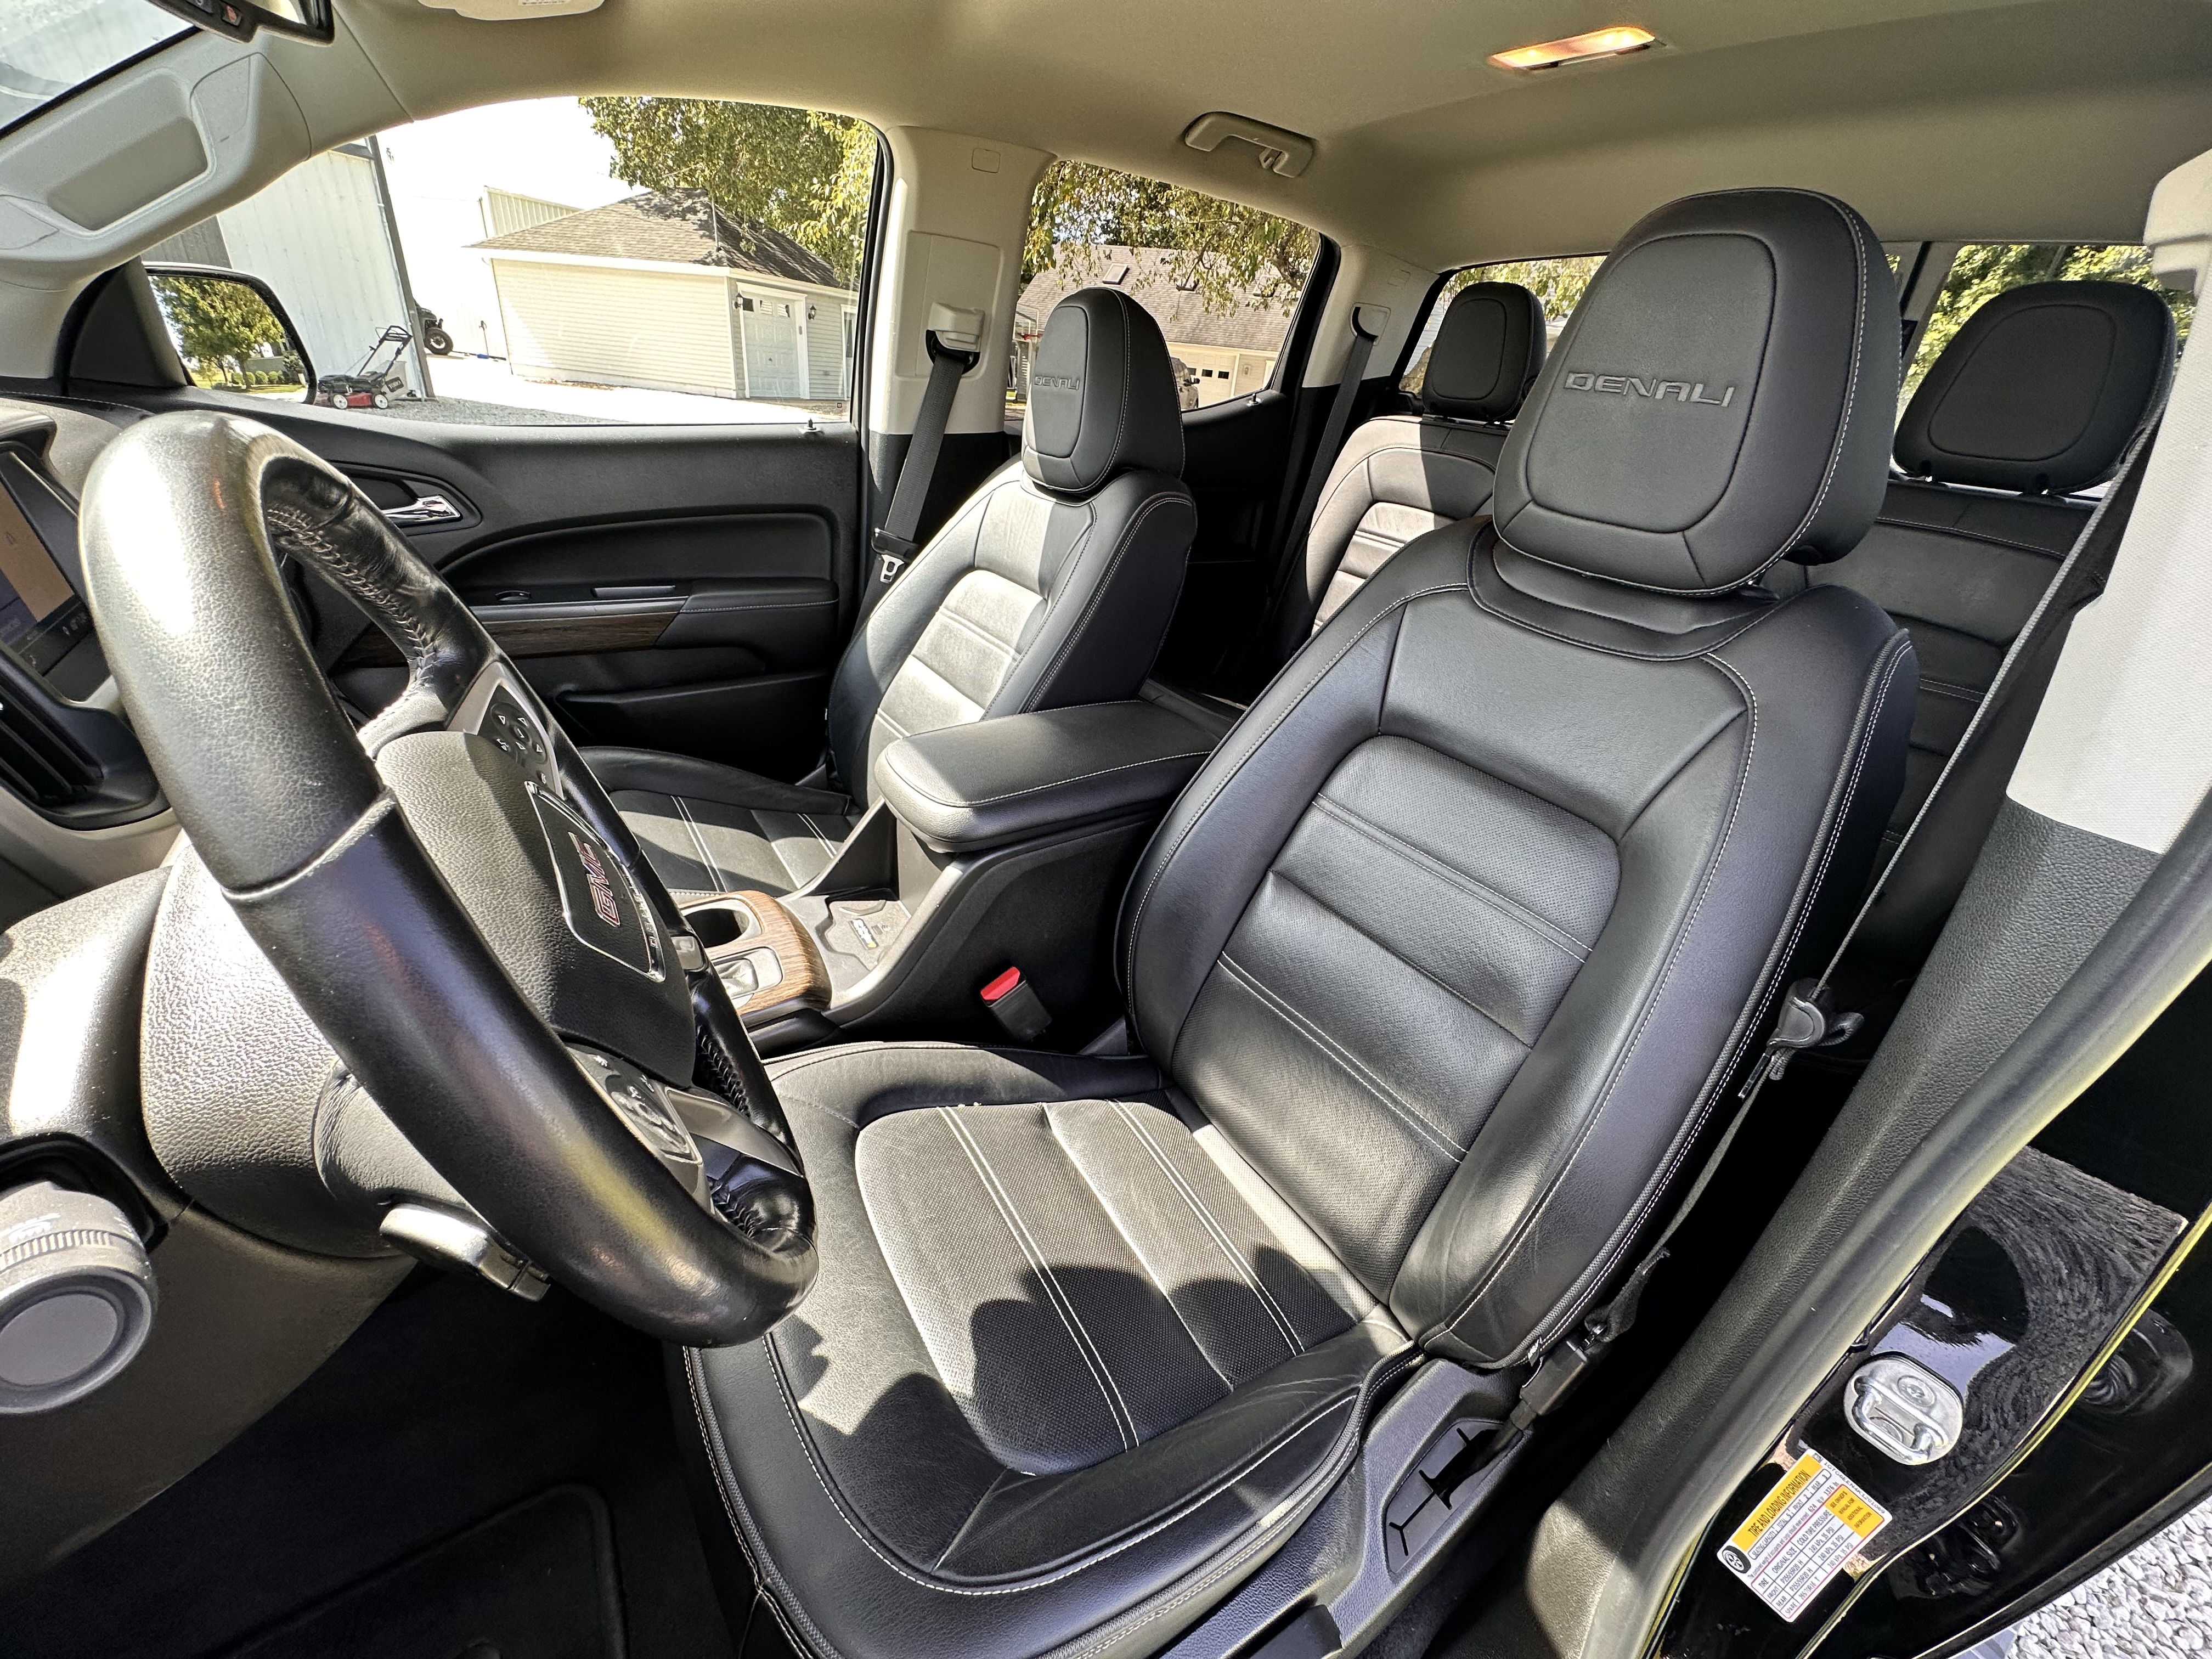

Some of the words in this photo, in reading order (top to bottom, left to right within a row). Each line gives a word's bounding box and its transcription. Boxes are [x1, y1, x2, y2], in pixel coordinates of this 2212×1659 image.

[1034, 375, 1080, 391] DENALI
[1564, 371, 1735, 407] DENALI
[568, 832, 620, 927] GMC
[1747, 1522, 1763, 1538] TIRE
[1756, 1513, 1771, 1528] AND
[1764, 1495, 1787, 1519] LOADING
[1779, 1469, 1811, 1502] INFORMATION
[1807, 1503, 1816, 1513] 624
[1823, 1485, 1835, 1496] 1376
[1796, 1533, 1809, 1546] COLD
[1805, 1526, 1816, 1537] TIRE
[1811, 1509, 1832, 1530] PRESSURE
[1825, 1526, 1835, 1534] PSI
[1835, 1533, 1844, 1543] PSI
[1844, 1542, 1854, 1551] PSI
[1771, 1554, 1790, 1573] ORIGINAL
[1786, 1546, 1797, 1558] SIZE
[1758, 1577, 1769, 1589] TIRE
[1767, 1585, 1780, 1599] FRONT
[1775, 1595, 1787, 1607] REAR
[1784, 1601, 1798, 1615] SPARE
